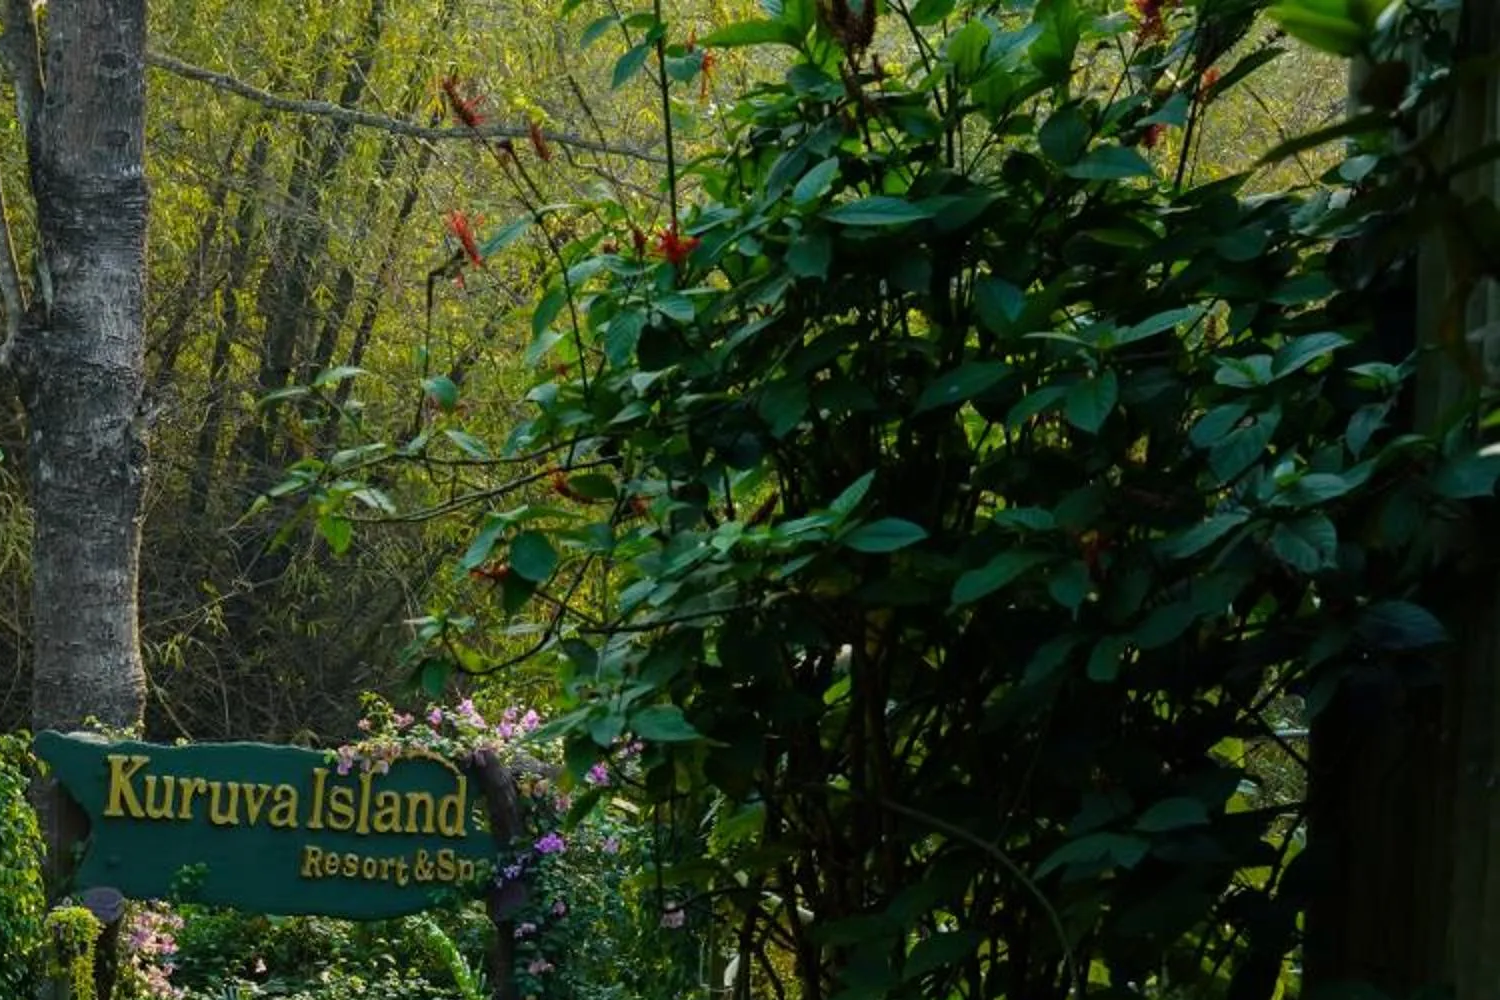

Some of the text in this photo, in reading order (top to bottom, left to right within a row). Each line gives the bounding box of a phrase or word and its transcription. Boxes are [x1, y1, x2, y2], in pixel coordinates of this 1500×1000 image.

[104, 754, 467, 837] Kuruva Island
[301, 844, 409, 886] Resort
